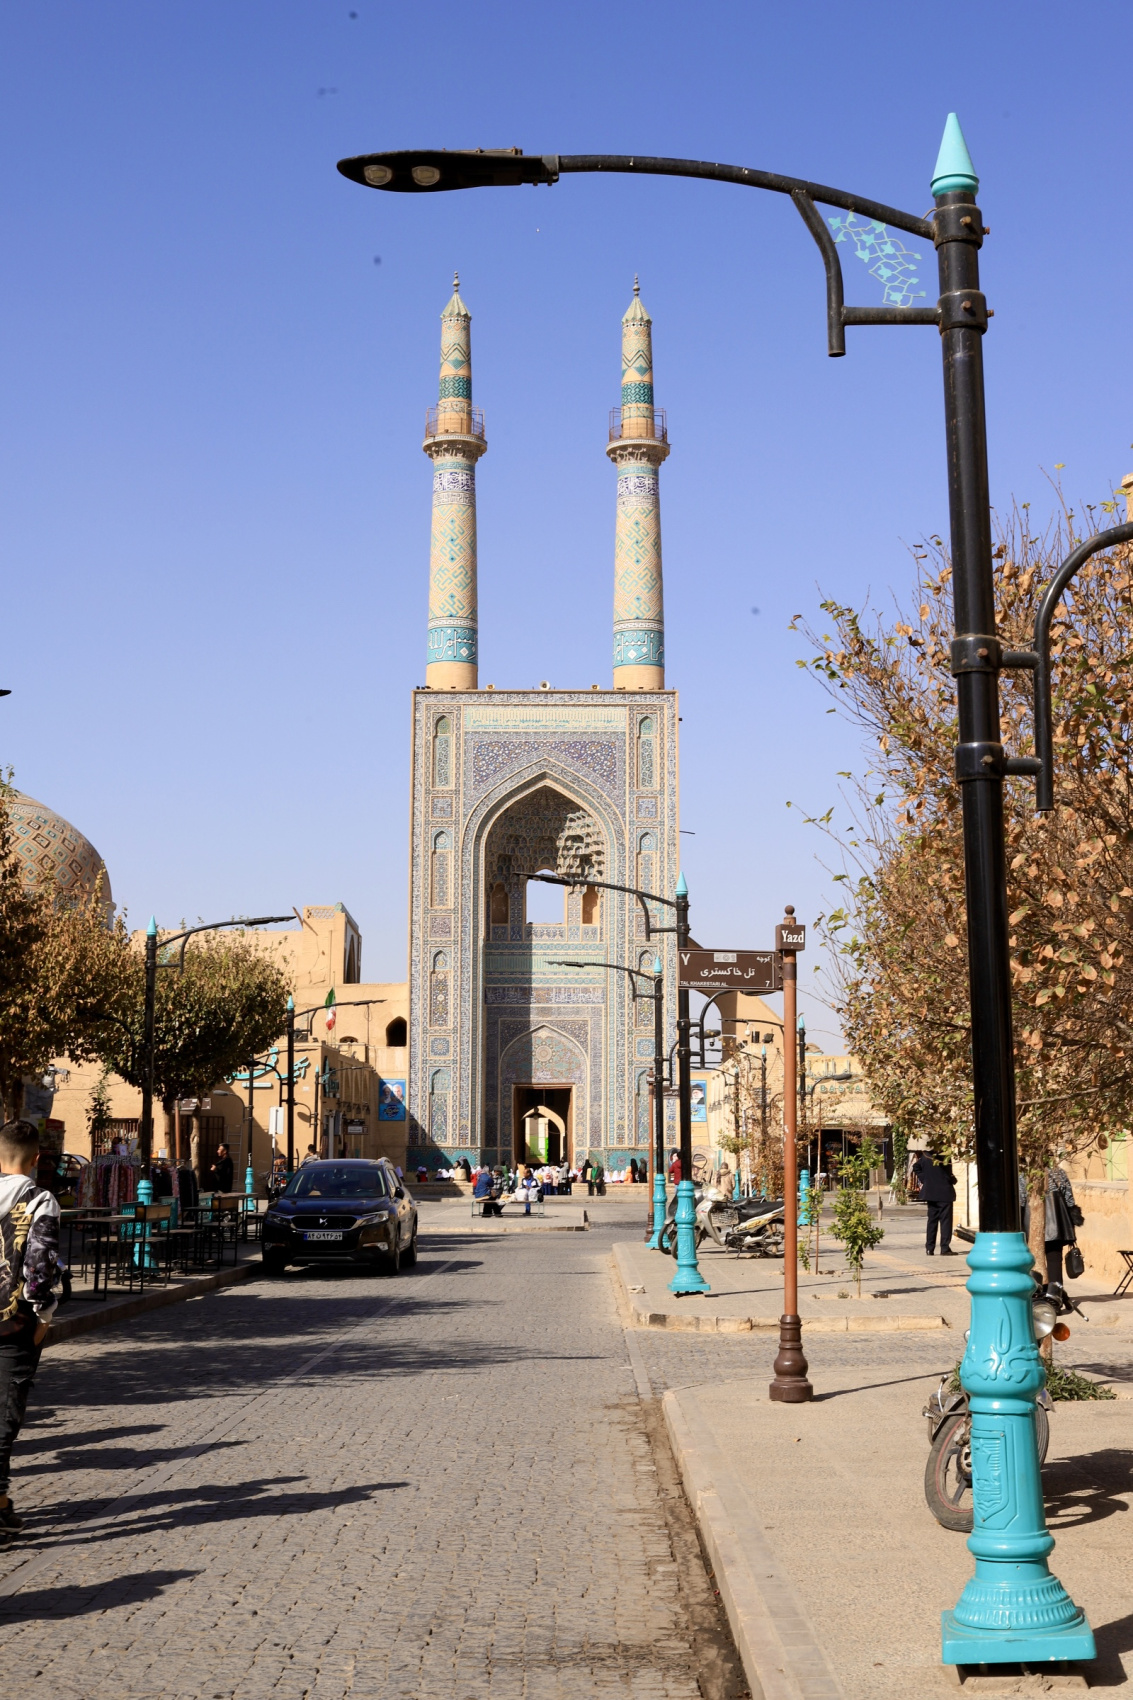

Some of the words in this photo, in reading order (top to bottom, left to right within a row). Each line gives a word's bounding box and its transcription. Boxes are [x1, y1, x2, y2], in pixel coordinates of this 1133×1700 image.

[781, 930, 804, 943] Yazd
[681, 953, 690, 965] ۷
[756, 955, 771, 963] کوچه
[743, 967, 756, 979] تل
